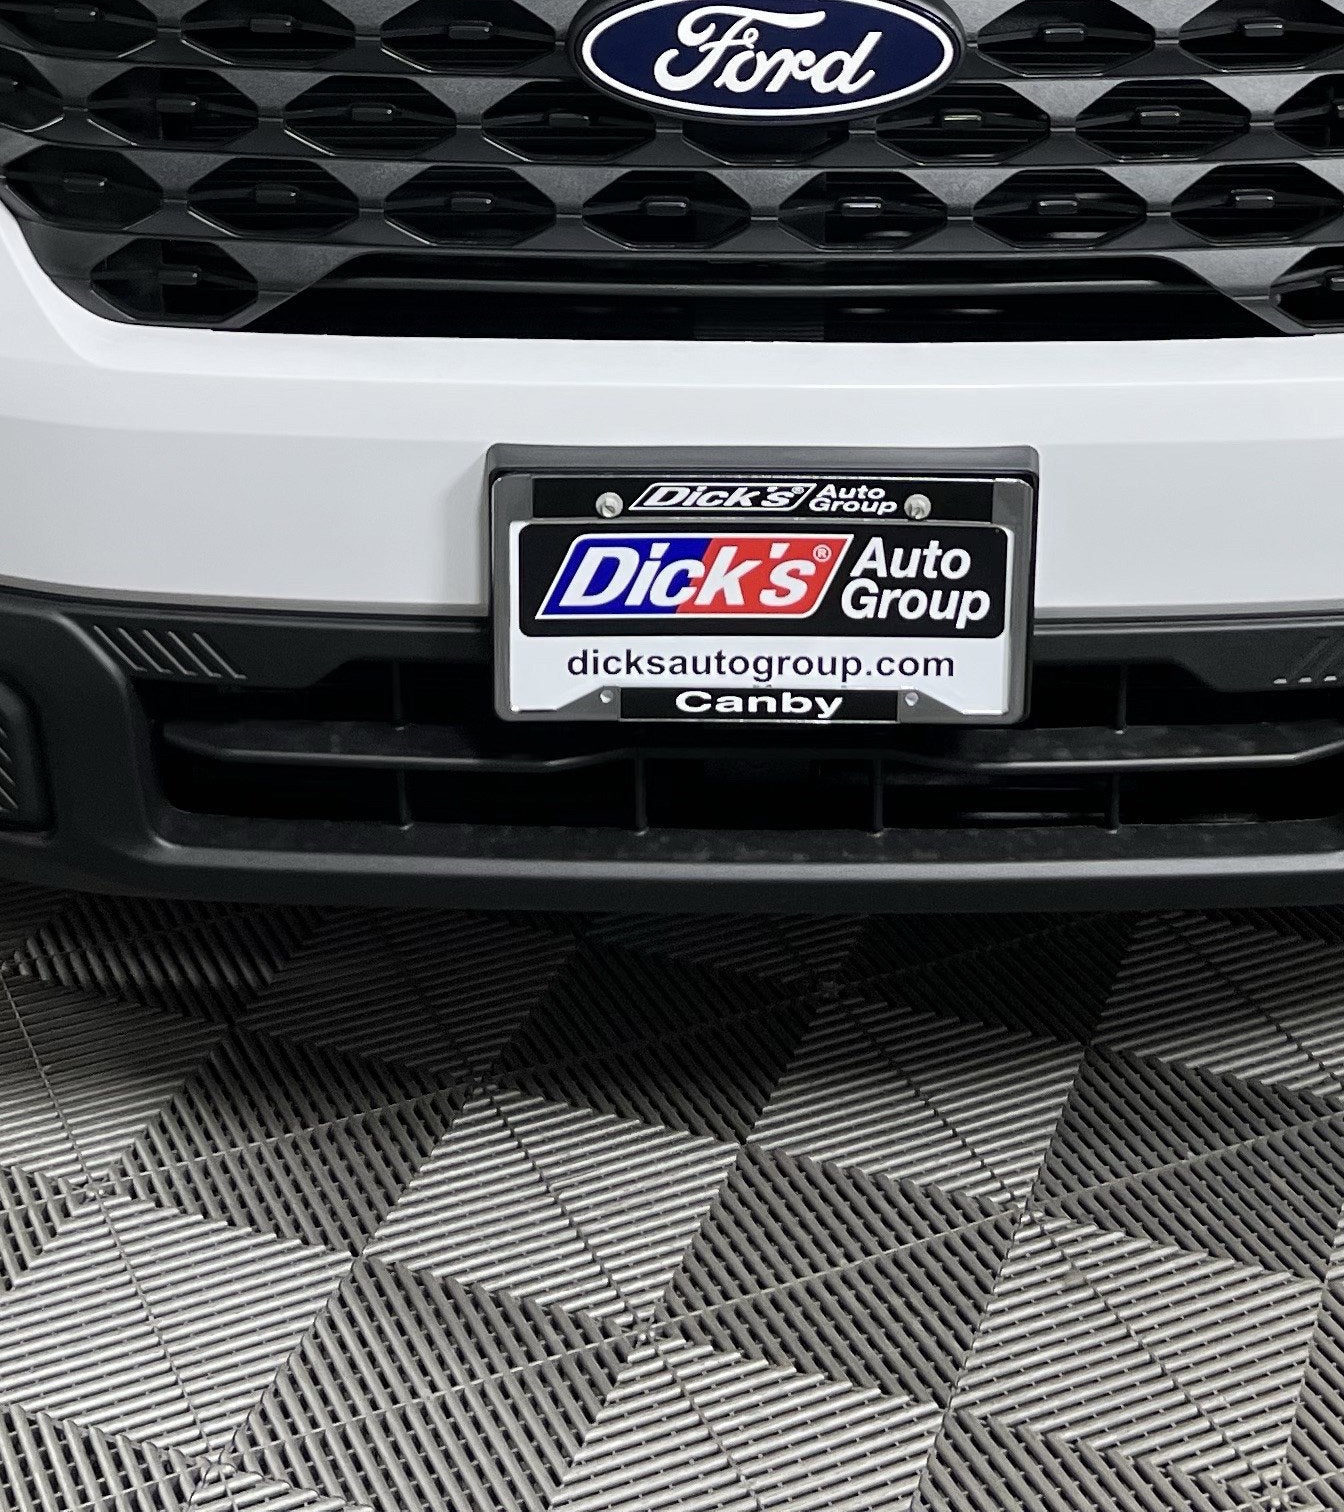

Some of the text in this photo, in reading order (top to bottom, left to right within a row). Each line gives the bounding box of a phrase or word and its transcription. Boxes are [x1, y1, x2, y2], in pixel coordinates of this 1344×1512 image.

[654, 5, 883, 94] Ford
[808, 497, 898, 515] Group
[815, 484, 885, 500] Auto
[849, 536, 971, 580] Auto
[841, 577, 991, 629] Group
[567, 649, 955, 682] dicksautogroup.com
[675, 690, 843, 718] Canby
